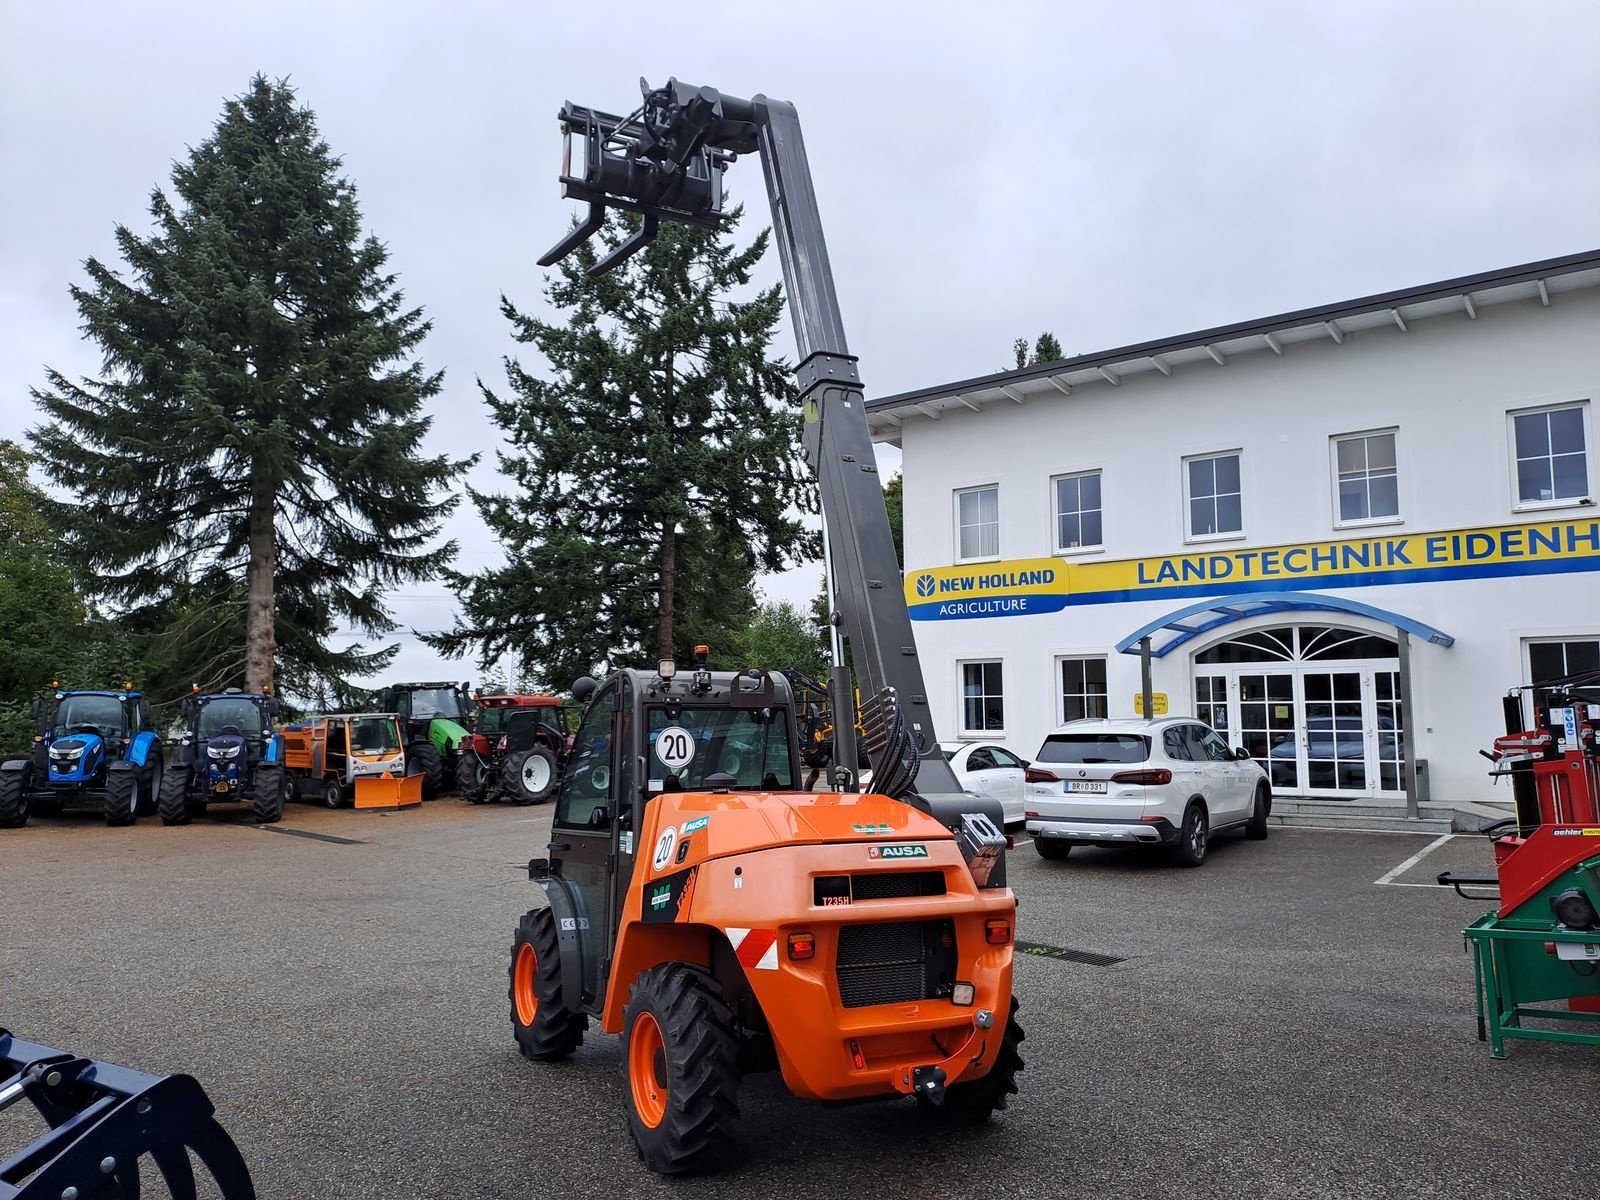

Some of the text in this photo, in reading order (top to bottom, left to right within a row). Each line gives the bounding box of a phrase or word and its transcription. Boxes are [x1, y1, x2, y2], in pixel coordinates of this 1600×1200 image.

[1137, 523, 1600, 585] LANDTECHNIK EIDENH
[940, 569, 1055, 592] NEW HOLLAND
[939, 598, 1027, 616] AGRICULTURE
[664, 735, 687, 760] 20
[685, 817, 707, 831] AUSA
[656, 834, 673, 864] 20
[882, 846, 926, 857] AUSA
[822, 896, 849, 906] T235H
